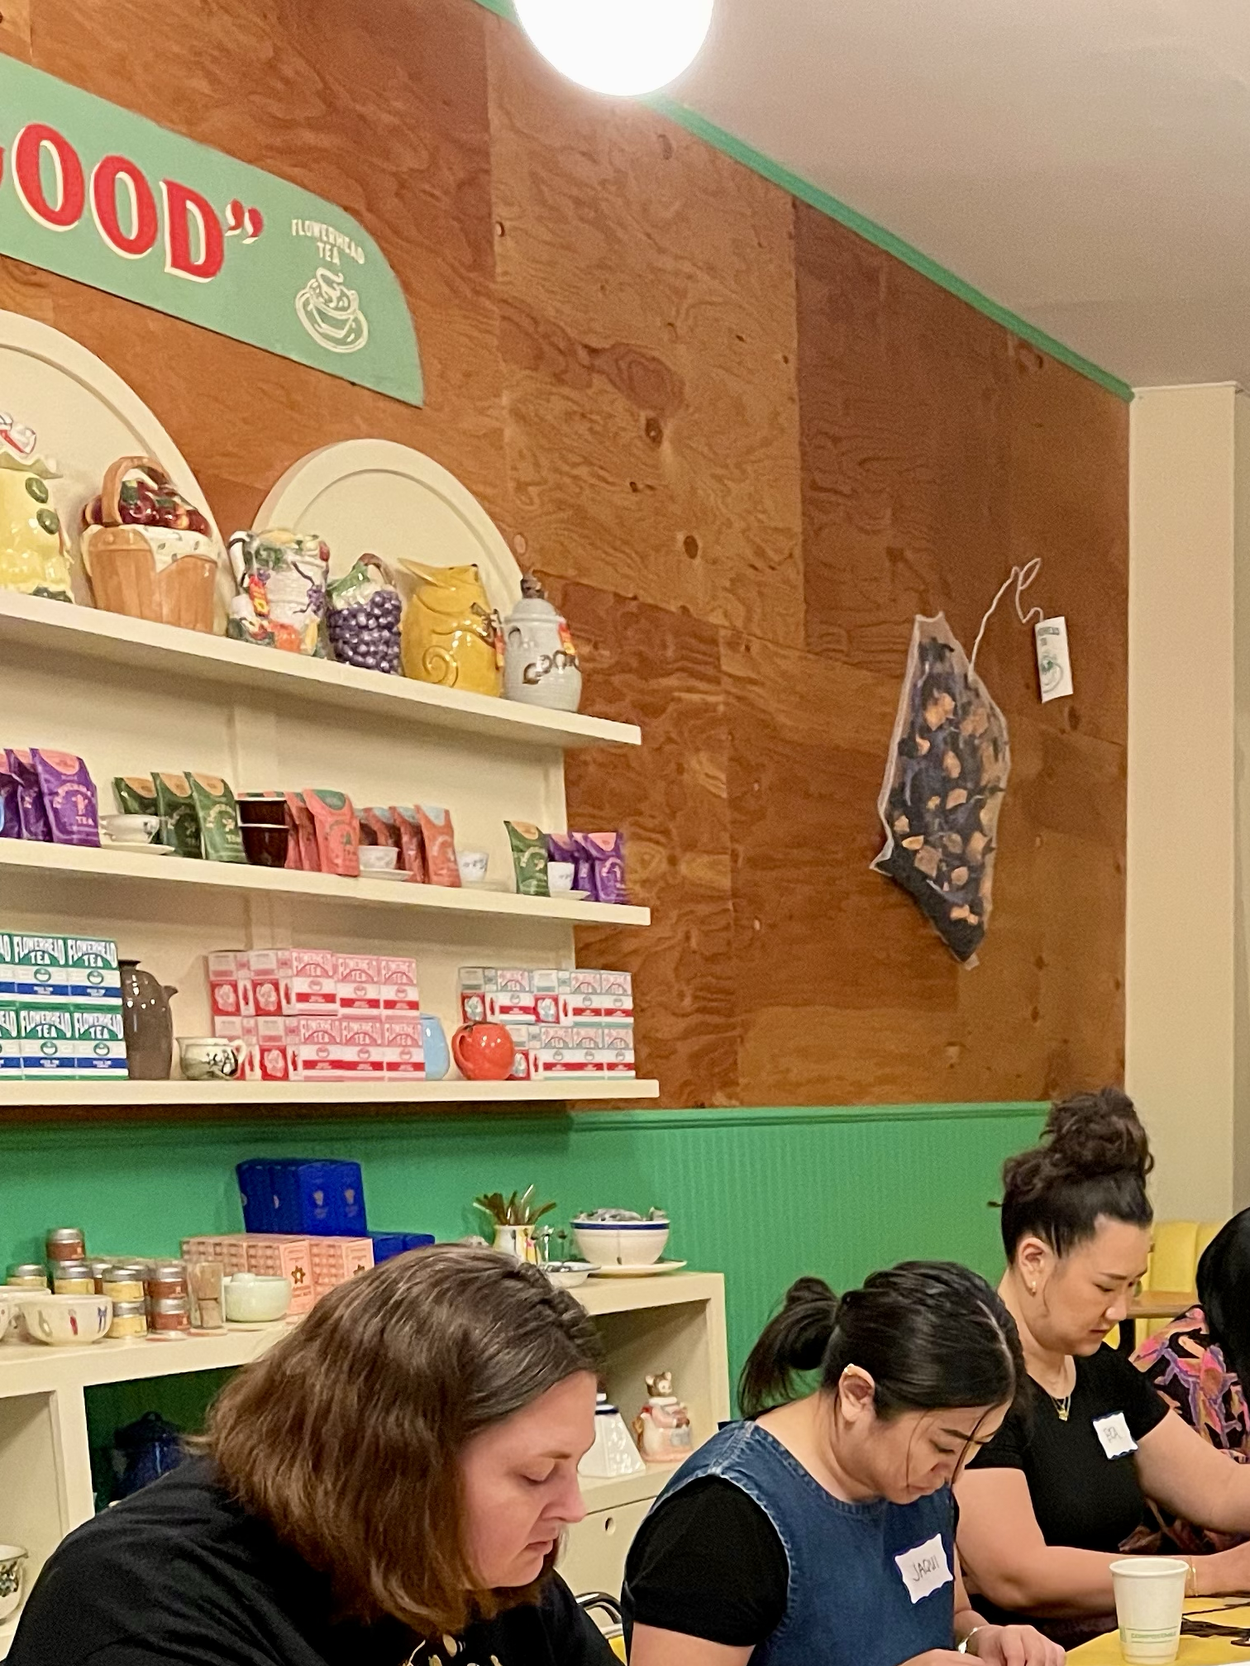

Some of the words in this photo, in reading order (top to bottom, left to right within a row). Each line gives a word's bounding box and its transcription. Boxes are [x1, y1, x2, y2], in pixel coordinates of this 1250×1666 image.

[0, 122, 264, 283] OOD”
[291, 219, 366, 265] FLOWERHEAD
[316, 241, 341, 266] TEA
[30, 951, 51, 966] TEA
[82, 954, 104, 968] TEA
[36, 1024, 58, 1039] TEA
[89, 1026, 110, 1040] TEA
